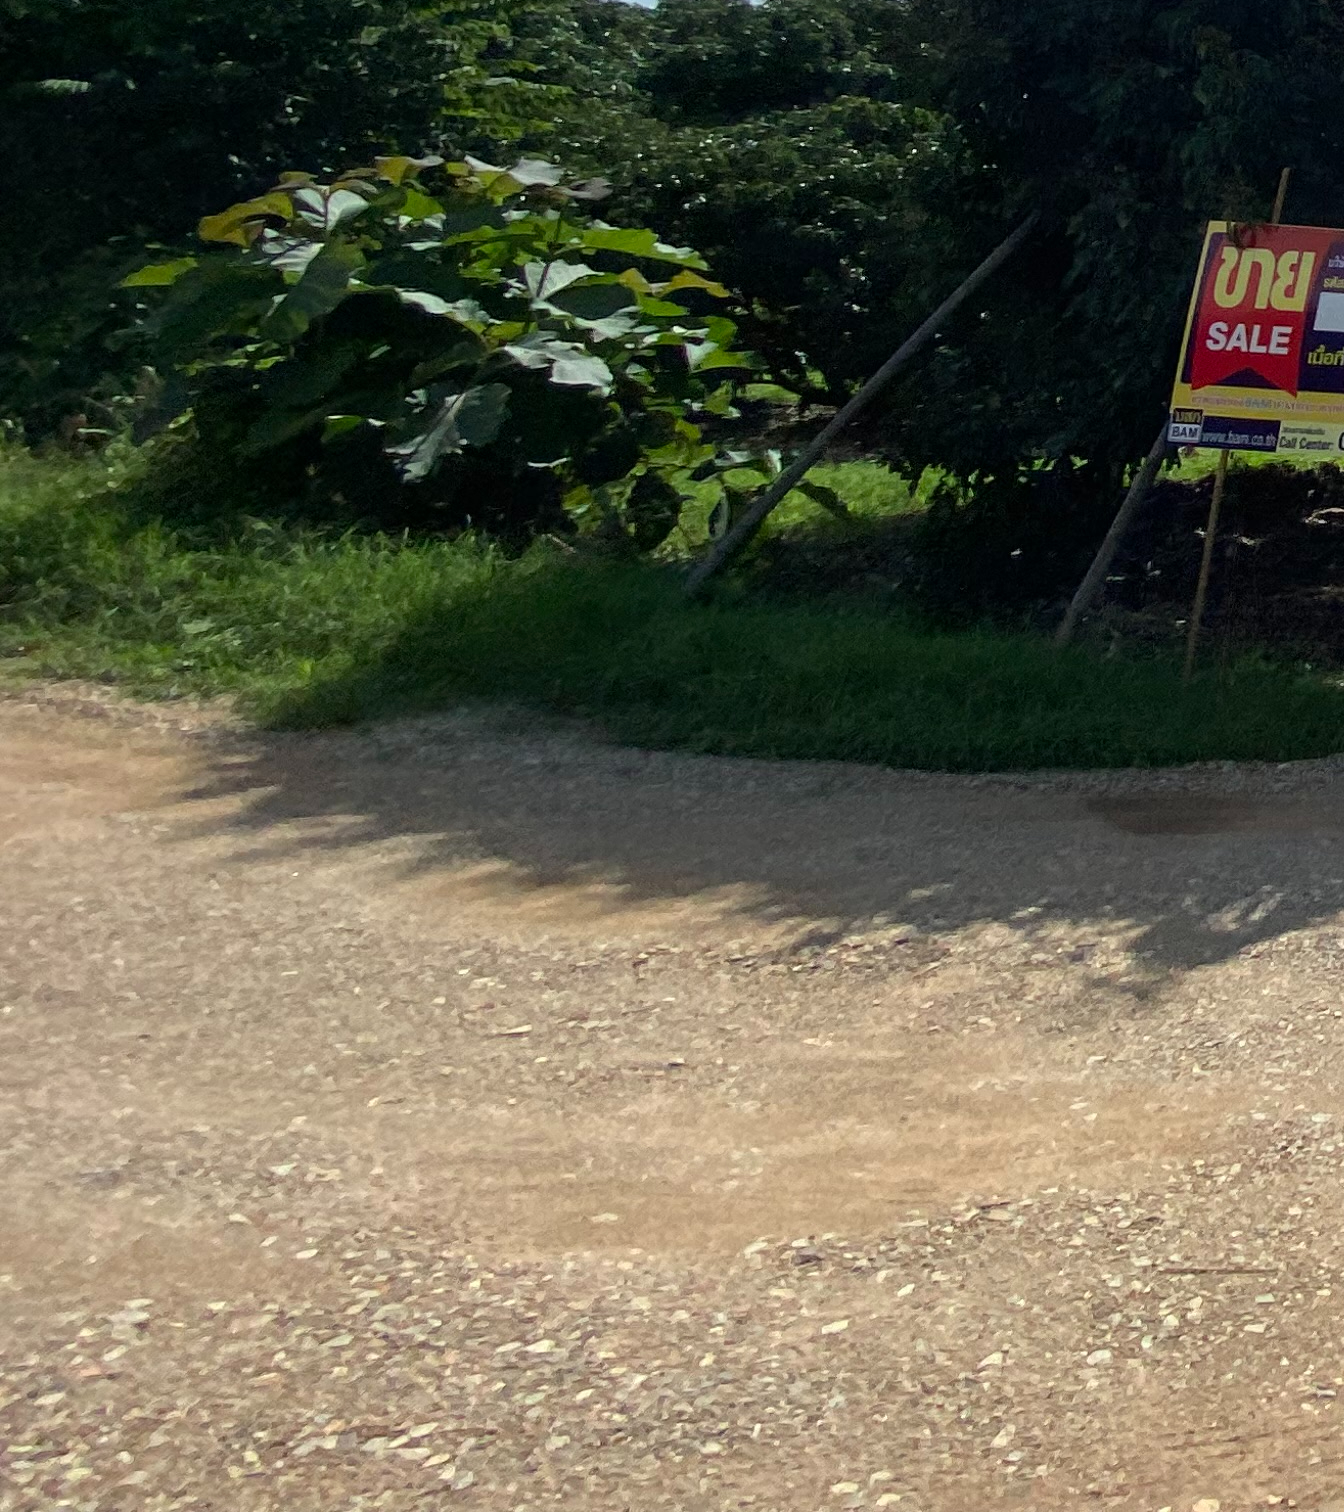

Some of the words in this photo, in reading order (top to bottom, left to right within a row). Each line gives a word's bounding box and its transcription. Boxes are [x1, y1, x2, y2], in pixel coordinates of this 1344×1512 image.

[1214, 247, 1317, 313] ขาย
[1206, 322, 1293, 355] SALE
[1171, 426, 1198, 438] BAM
[1279, 436, 1297, 448] Call
